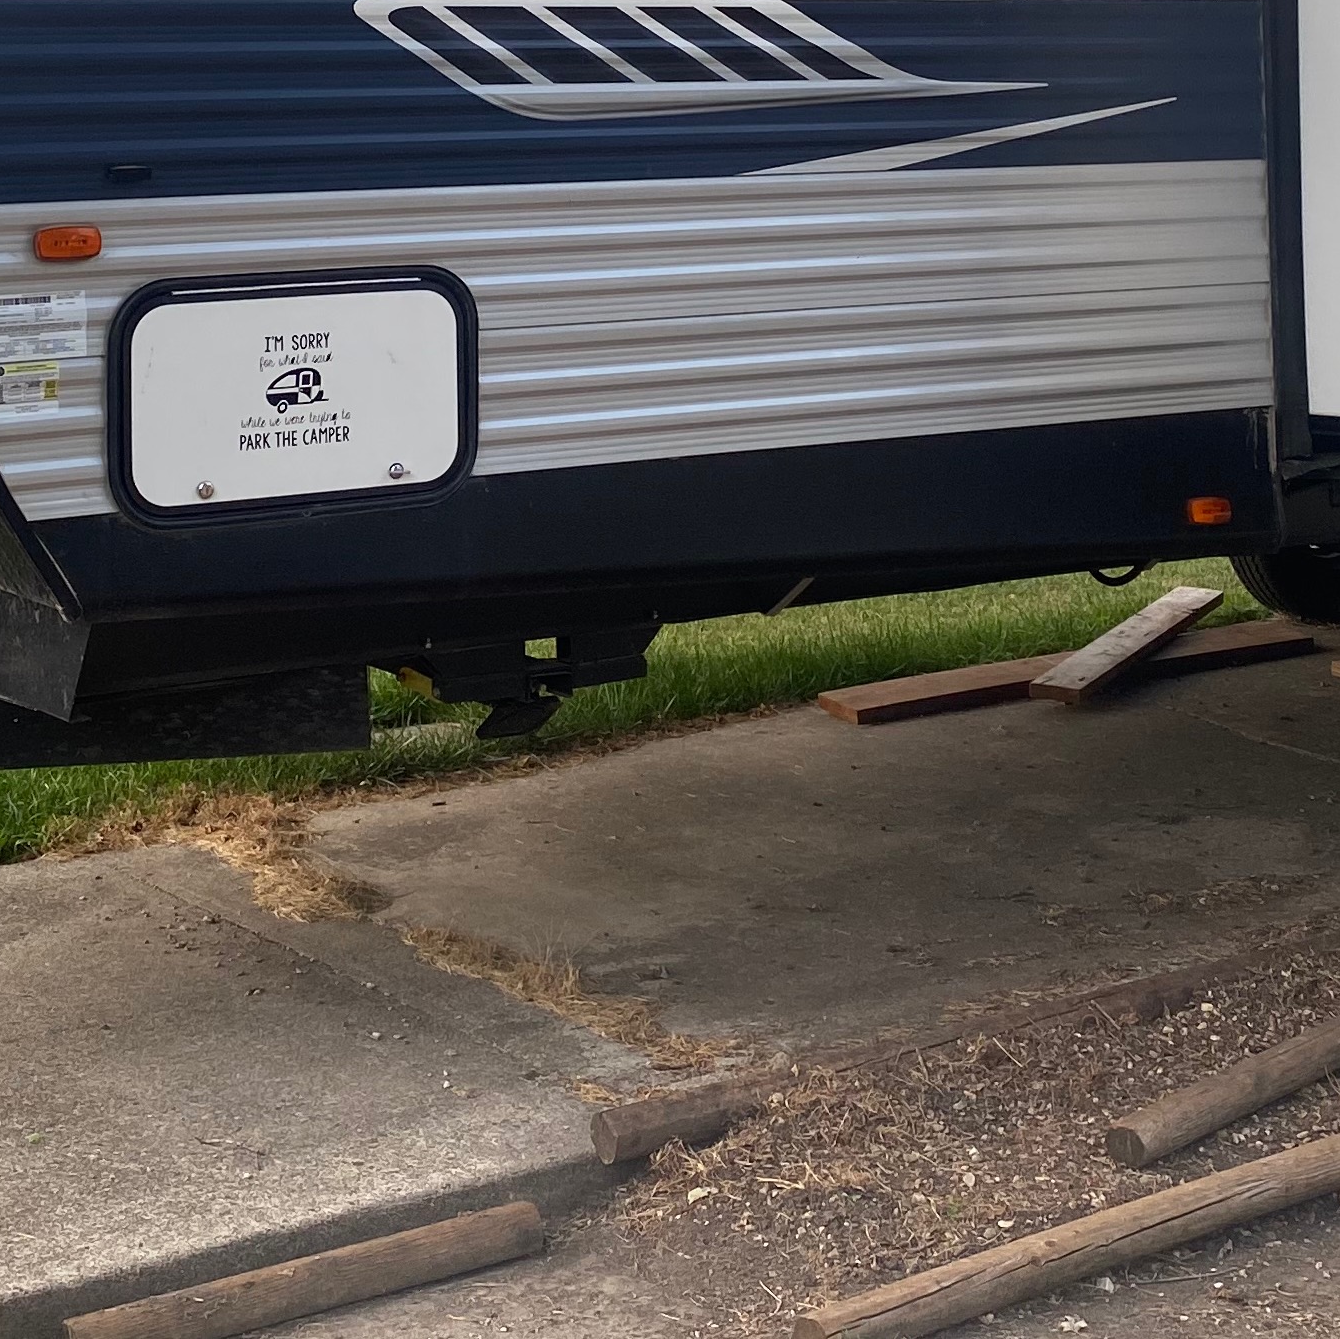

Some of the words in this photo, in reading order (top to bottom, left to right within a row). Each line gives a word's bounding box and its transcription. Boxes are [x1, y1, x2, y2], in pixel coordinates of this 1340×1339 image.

[264, 336, 284, 353] I'M
[292, 332, 330, 351] SORRY
[260, 356, 275, 372] for
[241, 416, 267, 429] while
[270, 418, 282, 427] we
[285, 415, 305, 426] were
[309, 411, 338, 427] trying
[341, 408, 351, 420] to
[239, 432, 271, 452] PARK
[275, 430, 298, 448] THE
[302, 425, 351, 446] CAMPER
